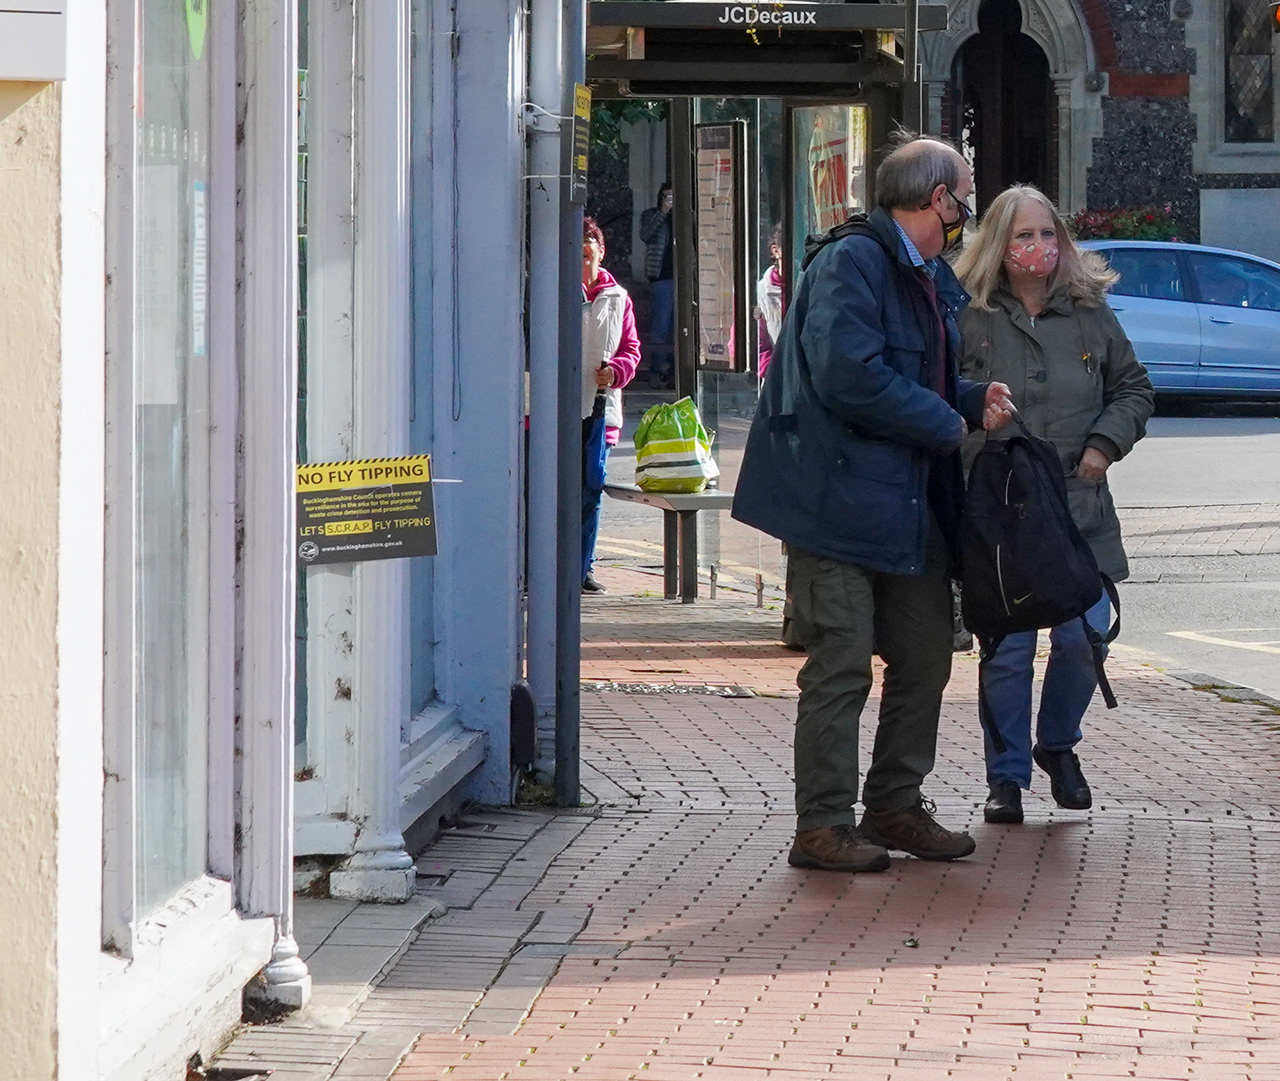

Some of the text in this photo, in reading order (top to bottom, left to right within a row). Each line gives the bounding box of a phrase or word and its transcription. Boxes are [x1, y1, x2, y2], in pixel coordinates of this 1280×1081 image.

[718, 6, 817, 24] JCDecaux
[298, 464, 424, 486] NO FLY TIPPING
[303, 495, 352, 504] Buckinghamshire
[305, 502, 340, 512] surveillance
[390, 498, 414, 506] purpose
[344, 508, 370, 516] detection
[326, 522, 372, 534] S.C.R.A.P.
[374, 520, 392, 530] FLY
[393, 517, 431, 528] TIPPING
[322, 540, 403, 552] www.buckinghamshire.gov.uk
